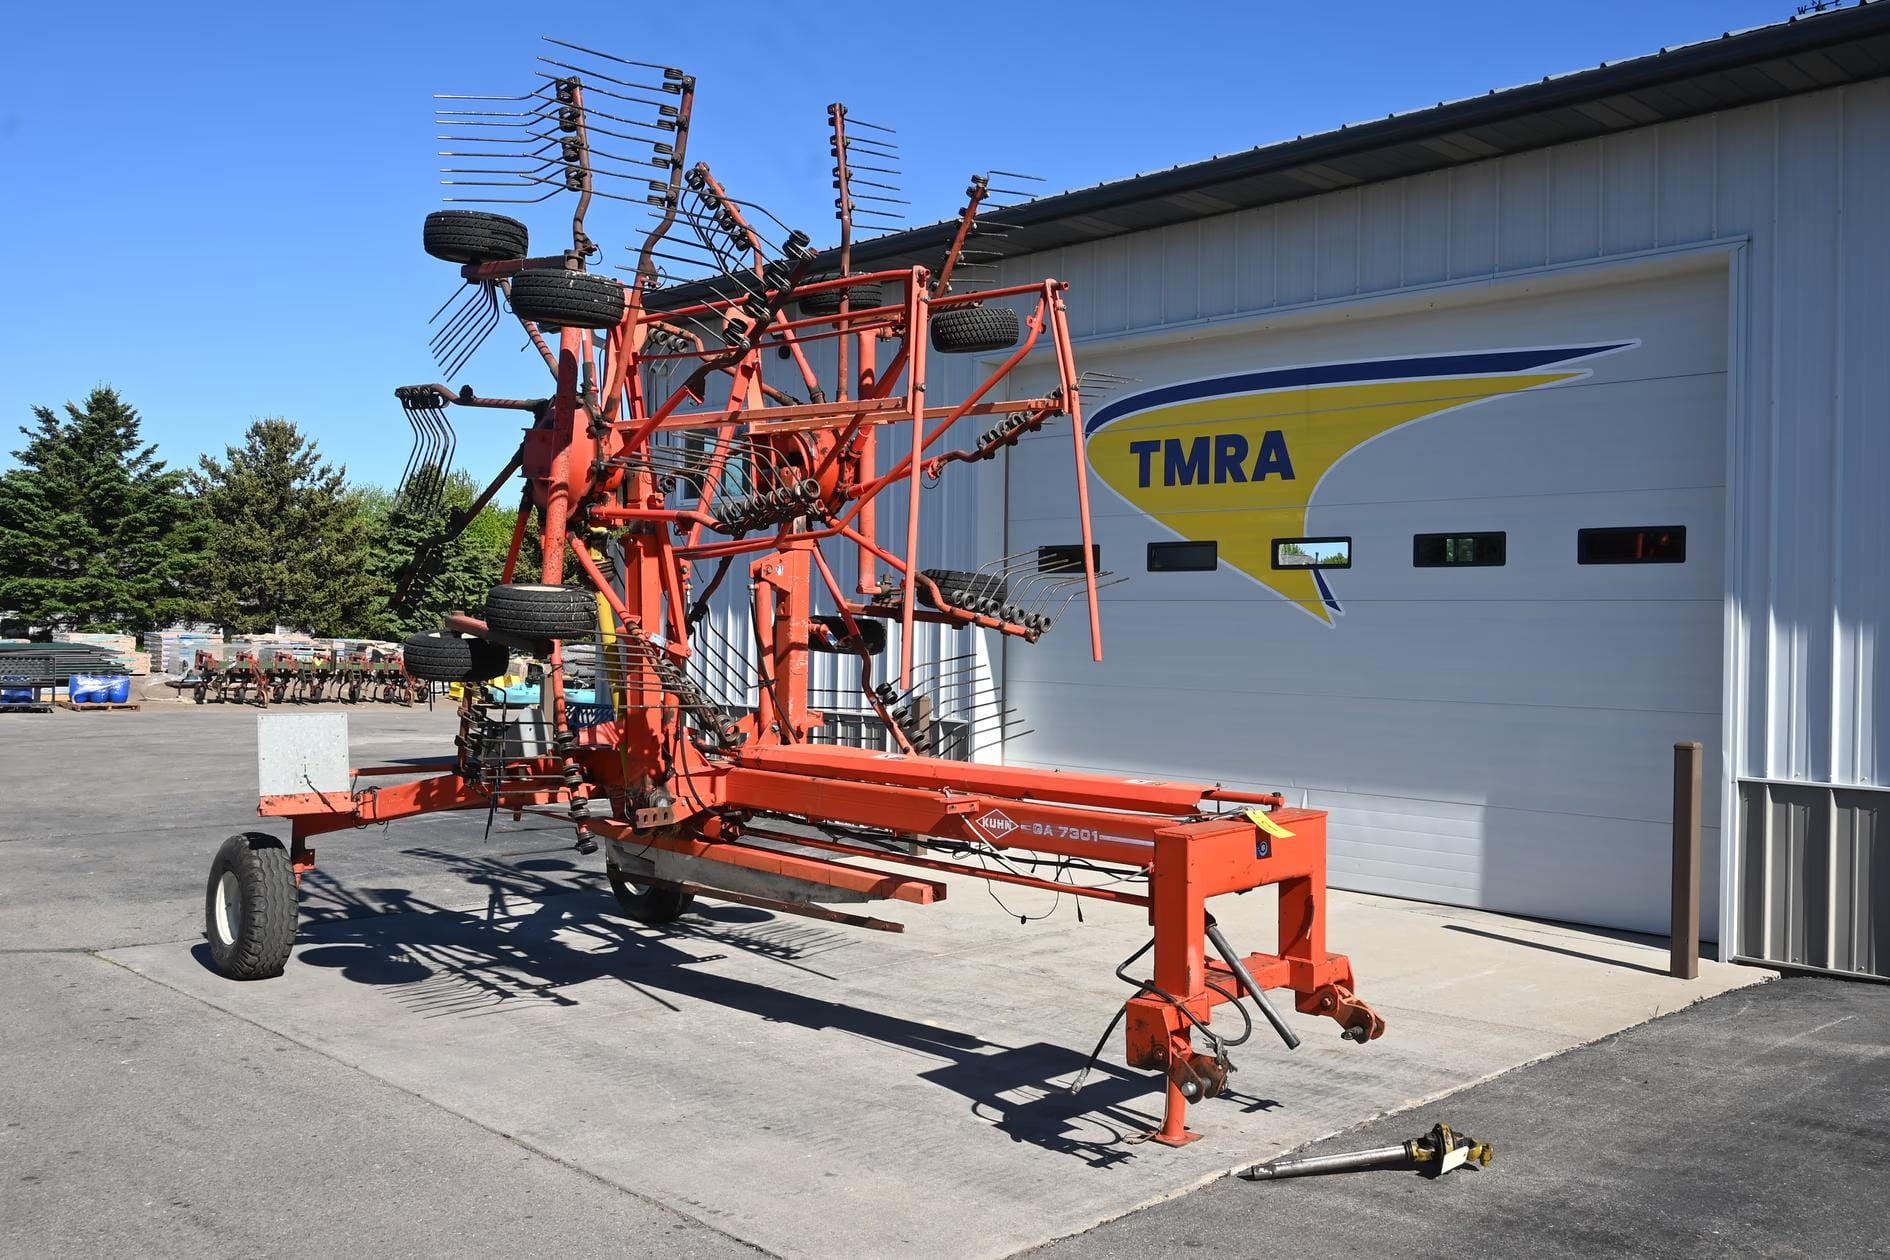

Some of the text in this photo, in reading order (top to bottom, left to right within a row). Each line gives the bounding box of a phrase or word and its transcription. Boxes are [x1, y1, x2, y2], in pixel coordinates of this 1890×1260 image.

[1130, 430, 1296, 489] TMRA
[982, 817, 1012, 831] KUHN
[1032, 823, 1099, 842] GA 7301
